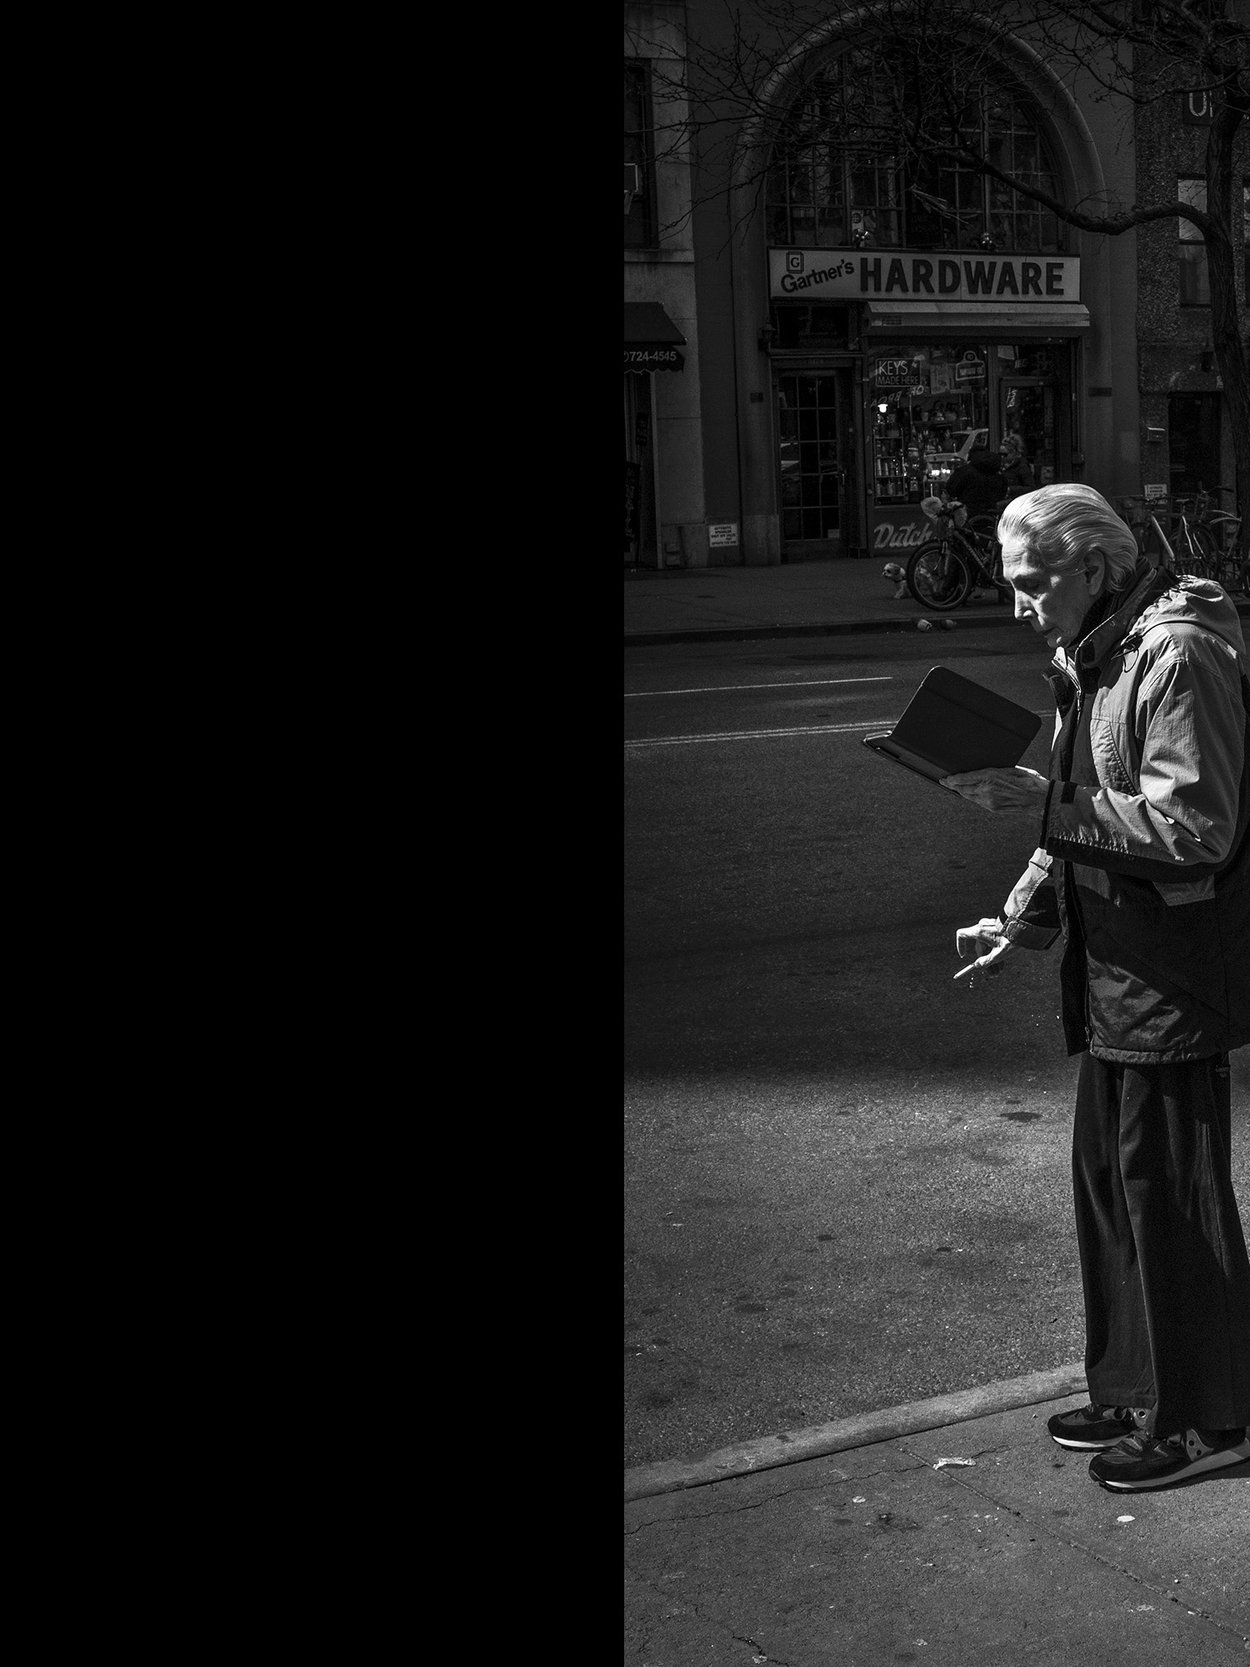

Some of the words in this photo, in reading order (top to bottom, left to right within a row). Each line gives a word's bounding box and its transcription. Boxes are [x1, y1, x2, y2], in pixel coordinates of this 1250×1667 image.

[780, 258, 855, 293] Gartner's
[860, 257, 1065, 296] HARDWARE
[878, 360, 908, 376] KEYS
[878, 376, 901, 386] MADE
[902, 376, 919, 386] HERE
[873, 522, 933, 549] Dutch
